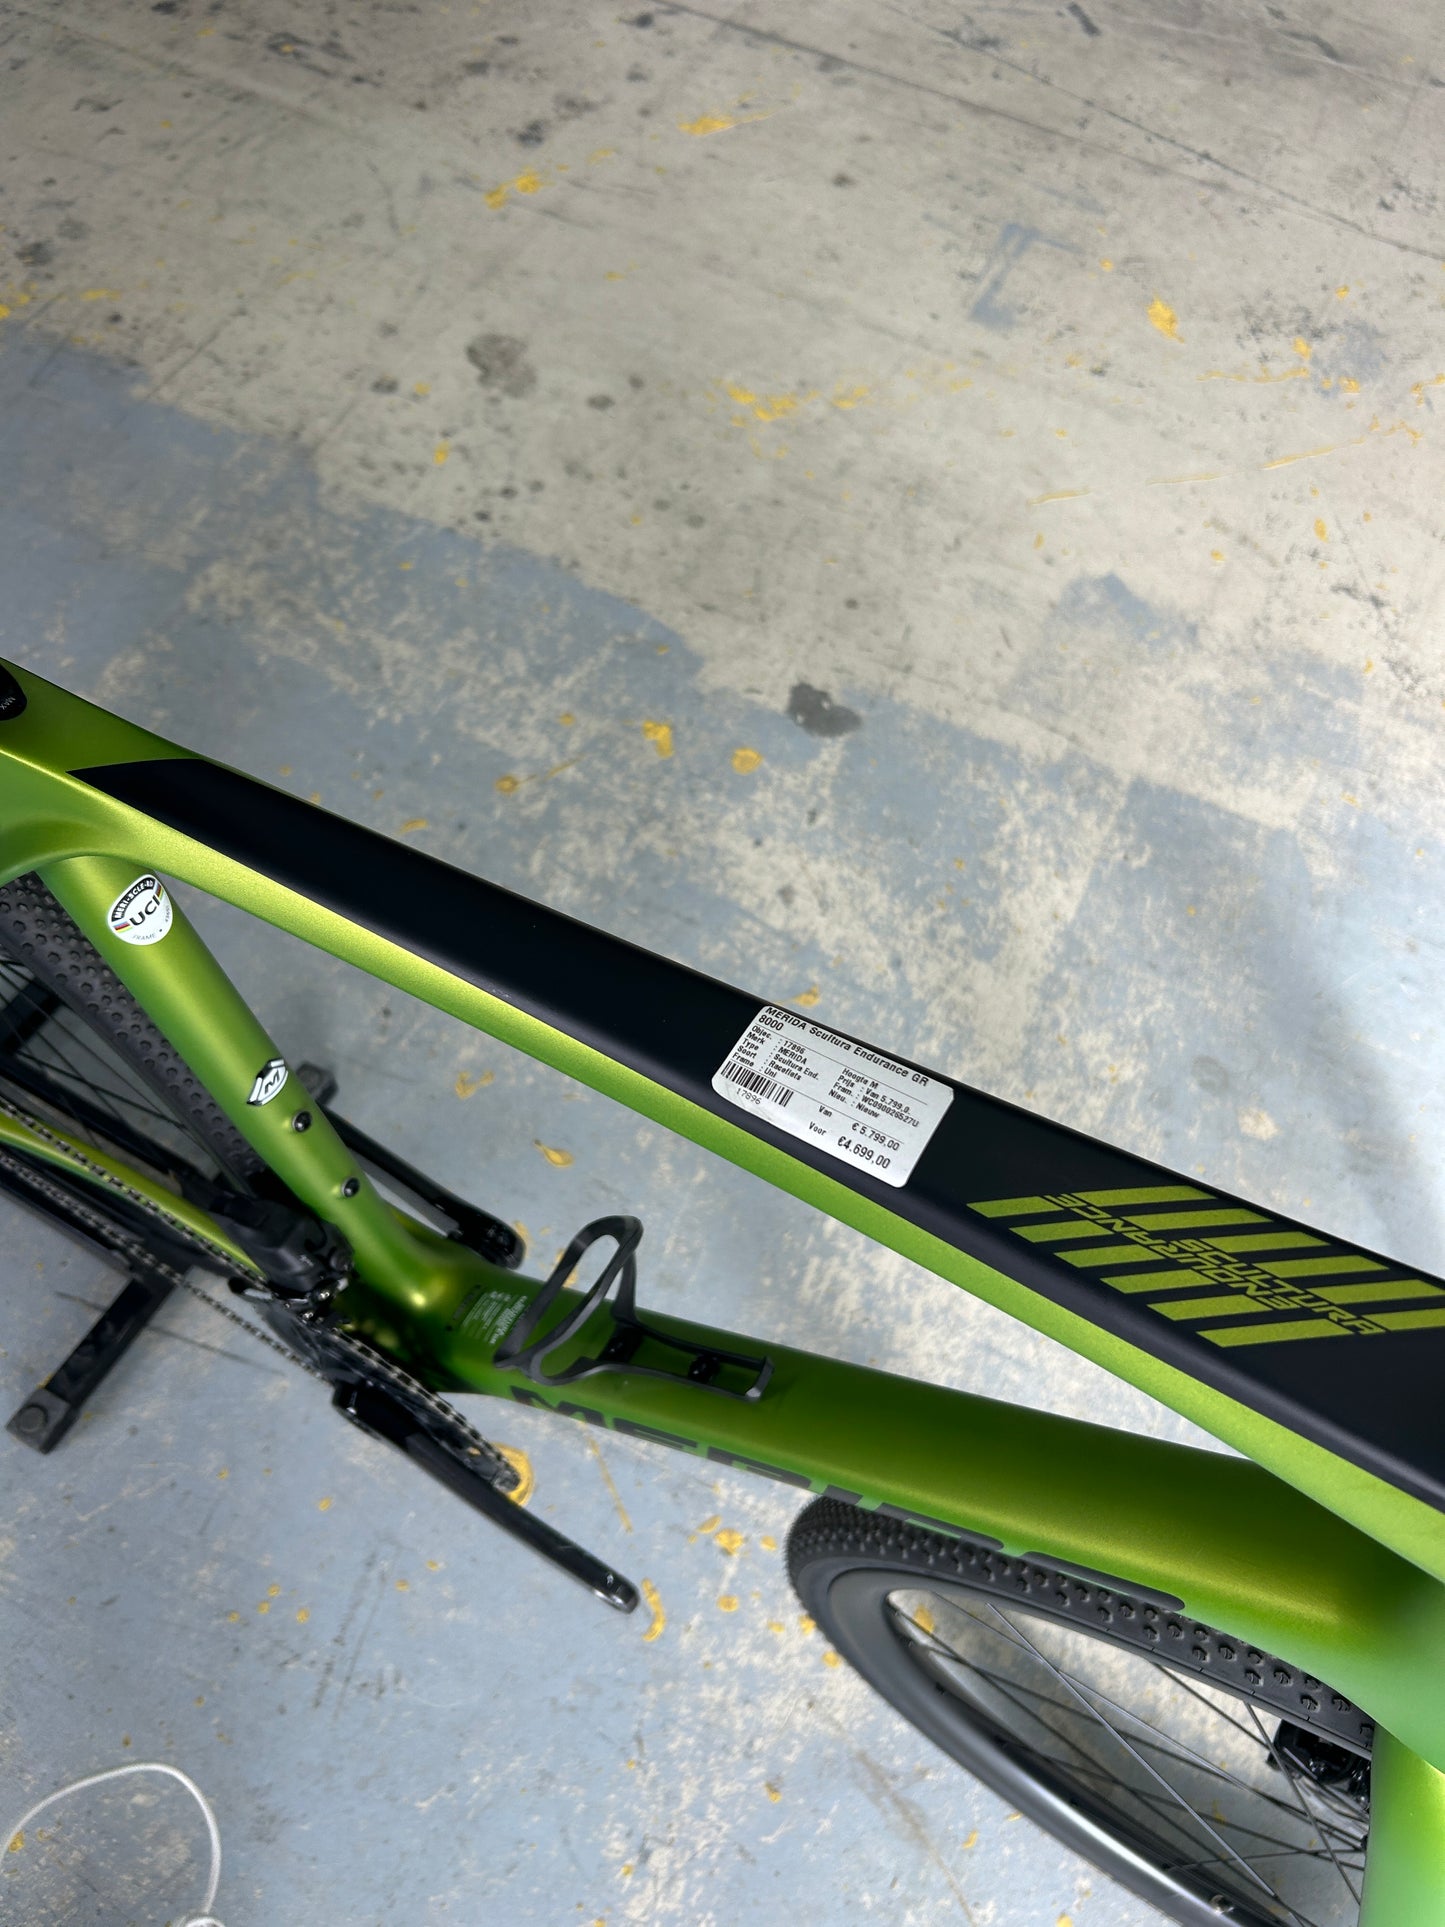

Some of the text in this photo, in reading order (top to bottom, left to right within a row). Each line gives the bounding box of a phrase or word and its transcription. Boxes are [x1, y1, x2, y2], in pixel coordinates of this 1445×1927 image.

[129, 895, 160, 925] UCI
[758, 1014, 784, 1031] 8000
[737, 1045, 757, 1059] Soort
[742, 1037, 759, 1051] Type
[773, 1053, 803, 1072] Scultura
[802, 1067, 819, 1080] End.
[746, 1031, 765, 1045] Merk
[777, 1046, 807, 1065] MERIDA
[765, 1005, 929, 1086] MERIDA Scultura Endurance GR
[783, 1040, 806, 1054] 17896
[732, 1051, 754, 1067] Frame
[763, 1066, 777, 1078] Uni
[841, 1067, 879, 1089] Hoogte M
[736, 1087, 762, 1105] 17896
[837, 1074, 855, 1088] Prijs
[865, 1087, 879, 1099] Van
[855, 1102, 880, 1118] Nieuw
[818, 1105, 832, 1117] Van
[859, 1125, 900, 1151] 5.799,00
[808, 1121, 891, 1169] Voor €4.699,00
[1177, 1238, 1387, 1335] SCULTURA
